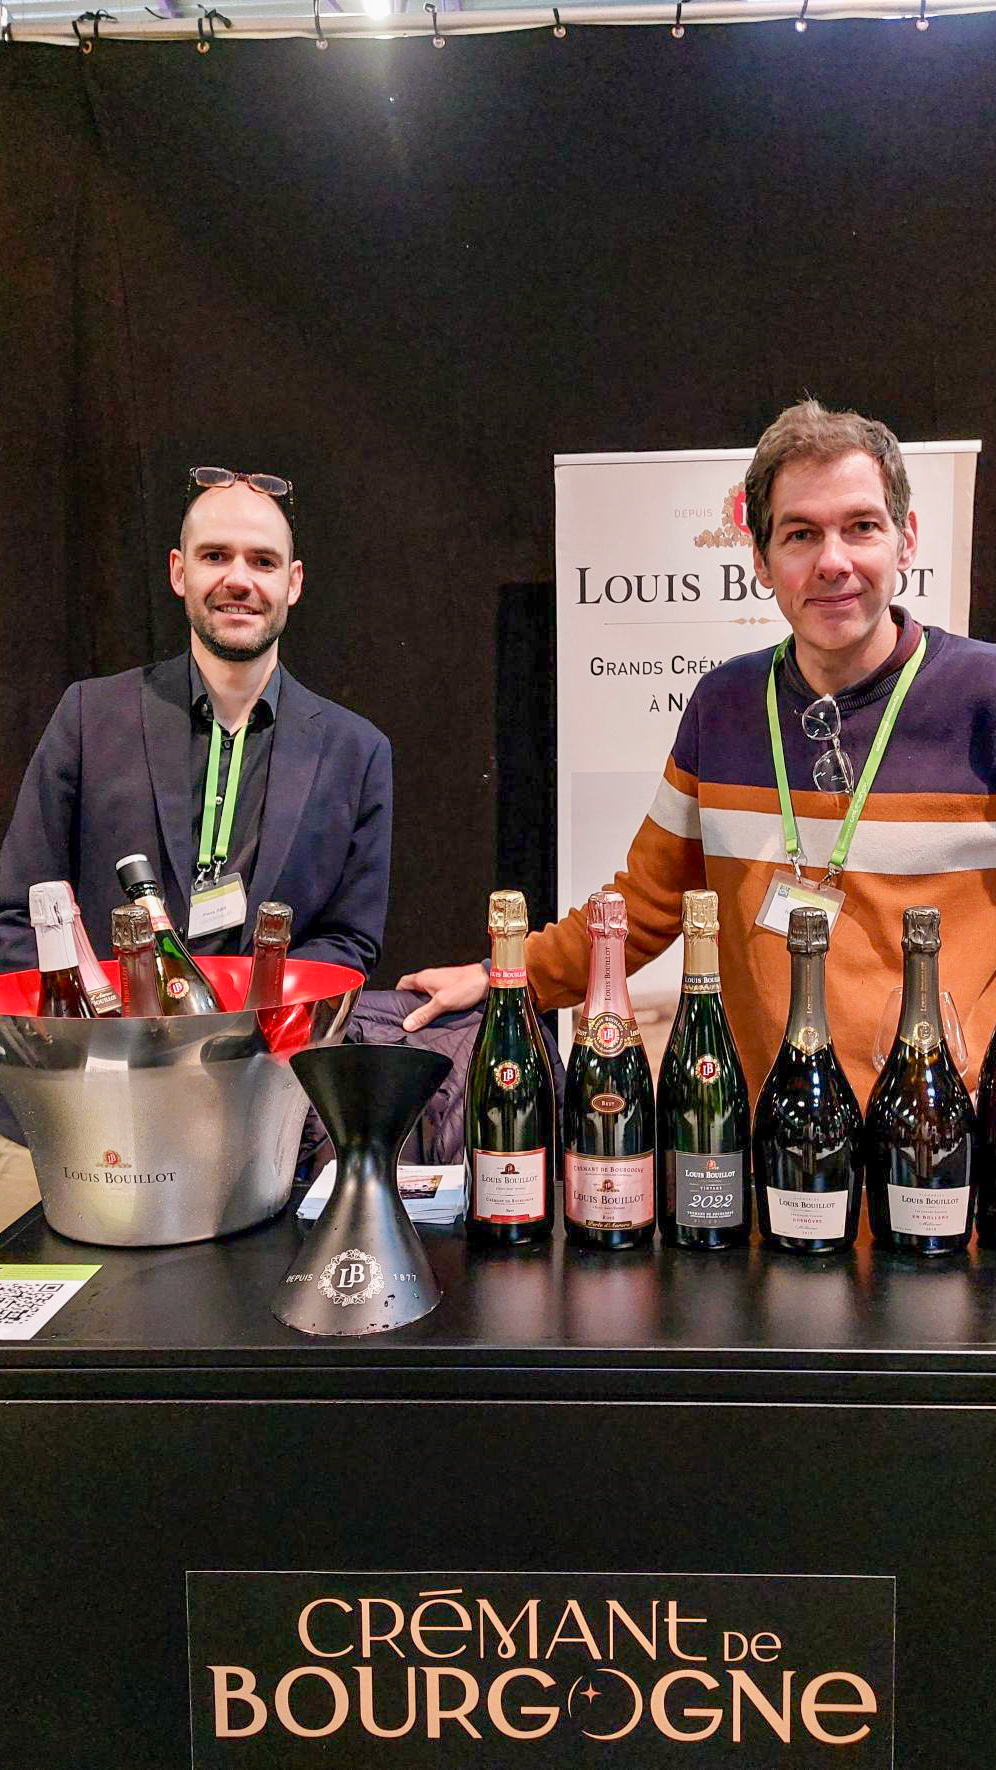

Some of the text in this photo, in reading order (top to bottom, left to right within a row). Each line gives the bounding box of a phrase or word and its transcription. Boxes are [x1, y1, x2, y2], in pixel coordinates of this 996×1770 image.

[674, 508, 713, 519] DEPUIS
[575, 567, 701, 604] LOUIS
[590, 656, 663, 676] GRANDS
[649, 695, 660, 713] À
[684, 976, 701, 984] LOUIS
[502, 1068, 514, 1082] LB
[702, 1062, 714, 1076] LB
[62, 1167, 177, 1184] LOUIS BOUILLOT
[482, 1174, 538, 1184] LOUIS BOUILLOT
[684, 1169, 736, 1179] LOUIS BOUILLOT
[573, 1190, 644, 1205] LOUIS BOUILLOT
[687, 1194, 734, 1209] 2022
[779, 1198, 799, 1208] LOUIS
[801, 1201, 836, 1209] BOUILLOT
[901, 1195, 959, 1205] LOUIS BOUILLOT
[286, 1273, 314, 1283] DEPUIS
[336, 1263, 365, 1288] LB
[393, 1273, 417, 1282] 1877
